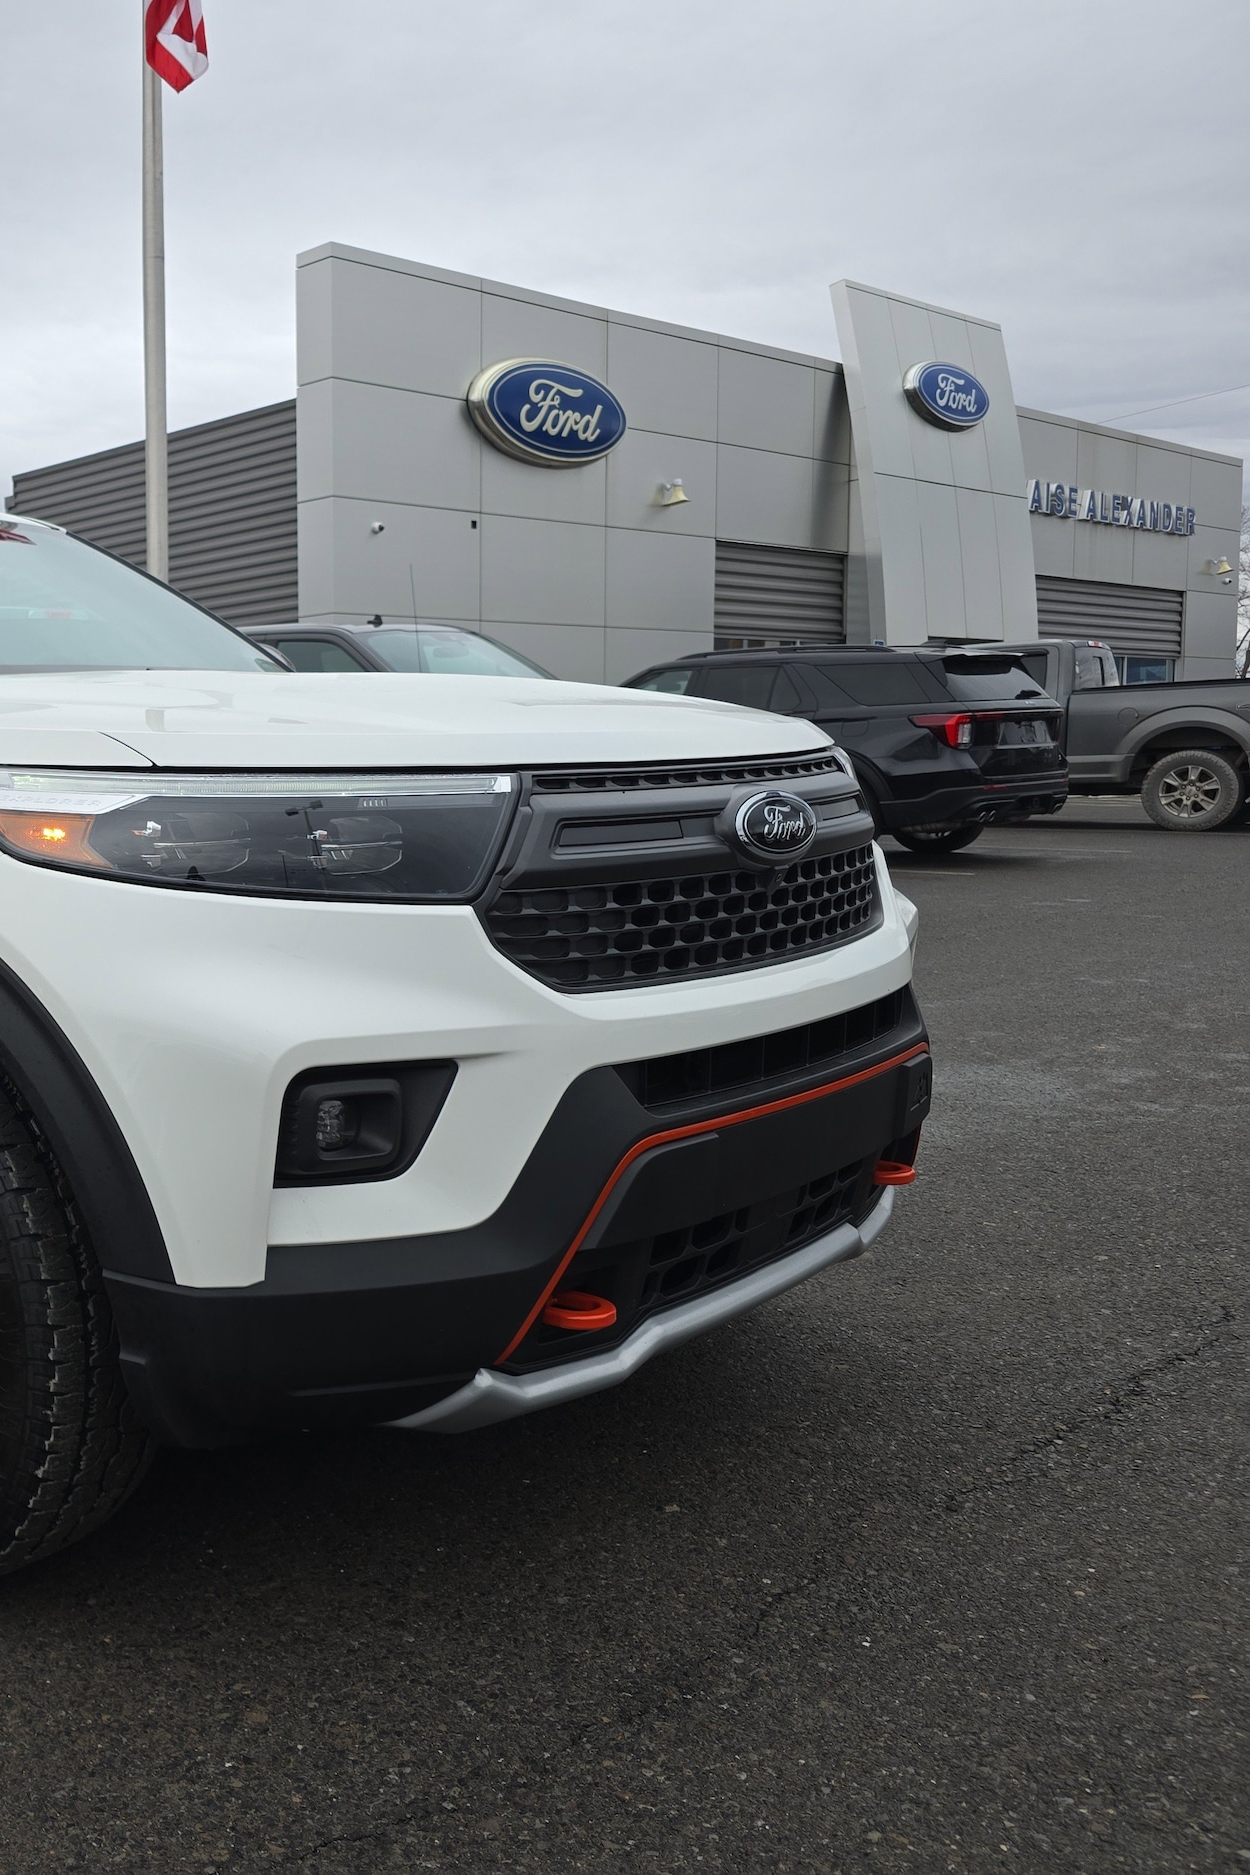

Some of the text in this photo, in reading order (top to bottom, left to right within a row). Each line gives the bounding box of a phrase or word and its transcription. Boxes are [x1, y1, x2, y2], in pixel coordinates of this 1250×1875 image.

[519, 378, 604, 443] Ford
[935, 373, 978, 414] Ford
[1078, 488, 1197, 536] ALEXANDER
[763, 804, 807, 841] Ford
